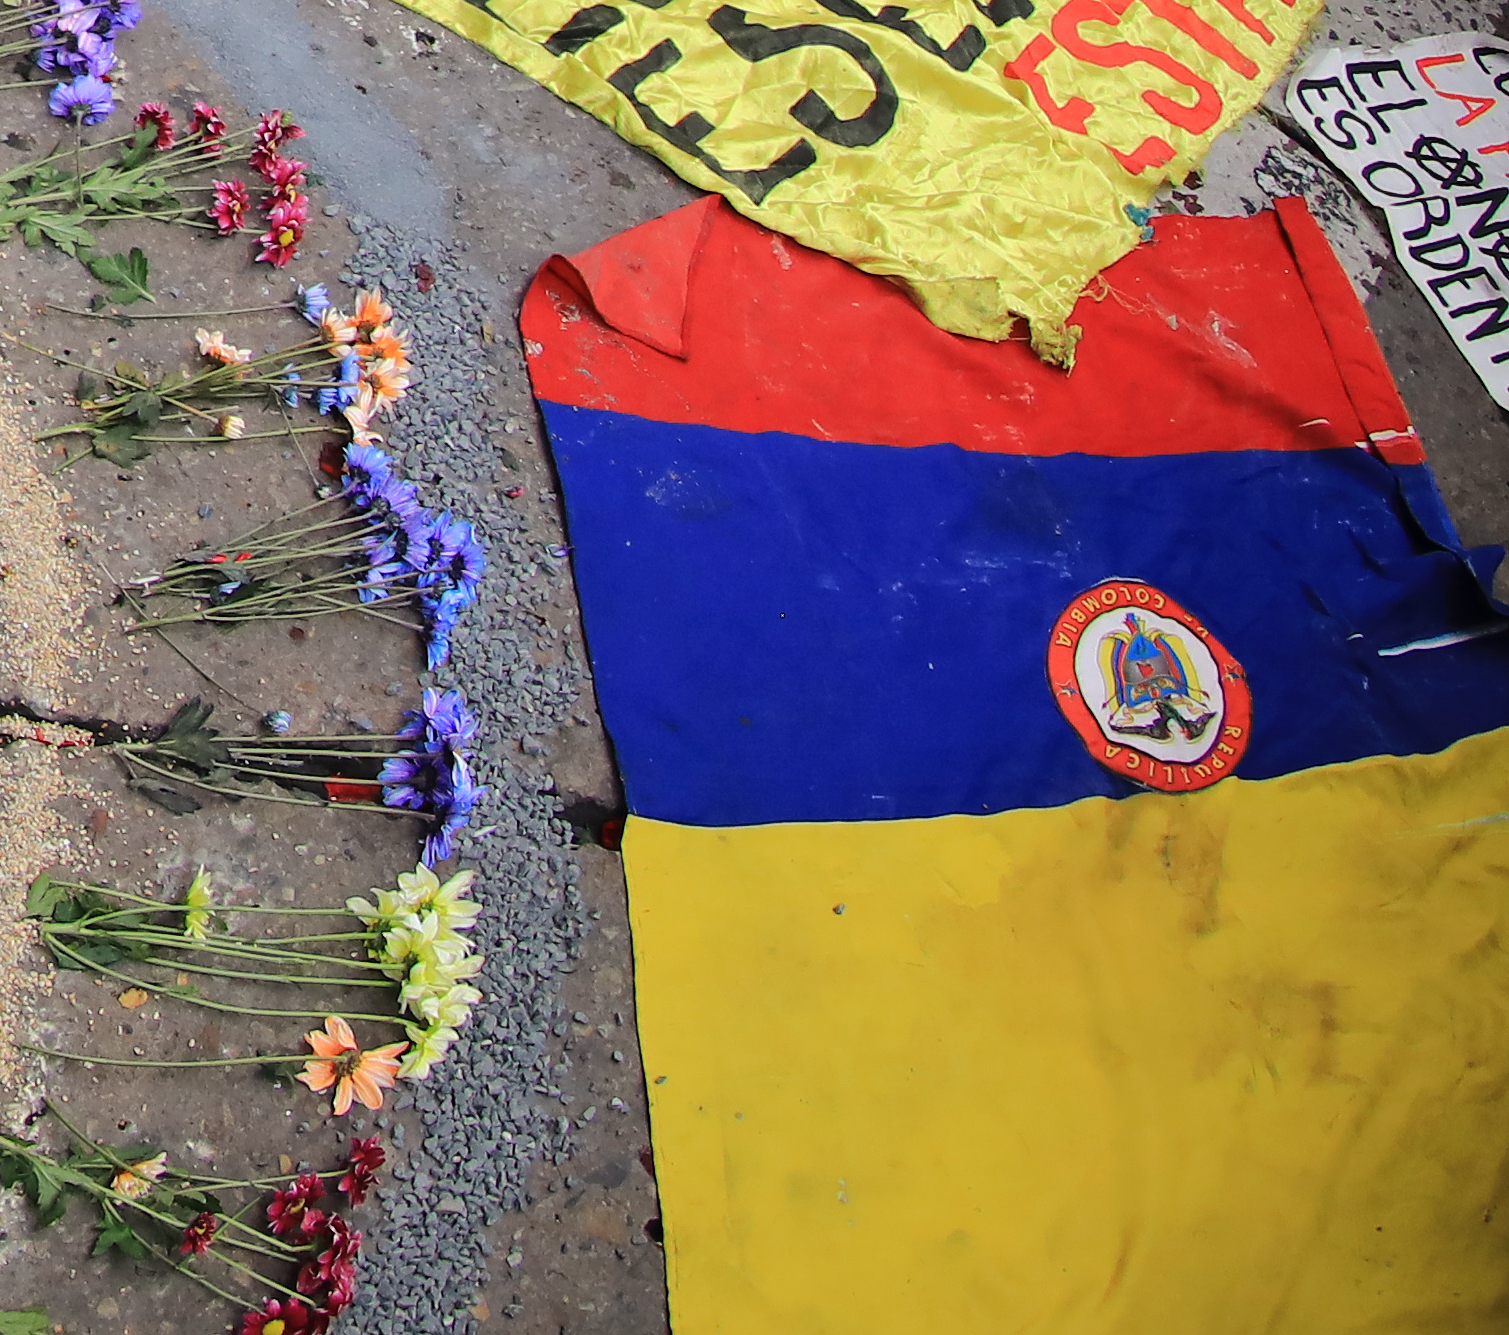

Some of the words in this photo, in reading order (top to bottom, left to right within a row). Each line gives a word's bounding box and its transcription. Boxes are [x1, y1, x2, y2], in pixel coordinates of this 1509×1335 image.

[610, 4, 900, 205] ES
[1296, 75, 1378, 152] ES
[1345, 59, 1428, 134] EL
[1415, 53, 1497, 128] LA
[1055, 585, 1166, 648] COLOMBIA
